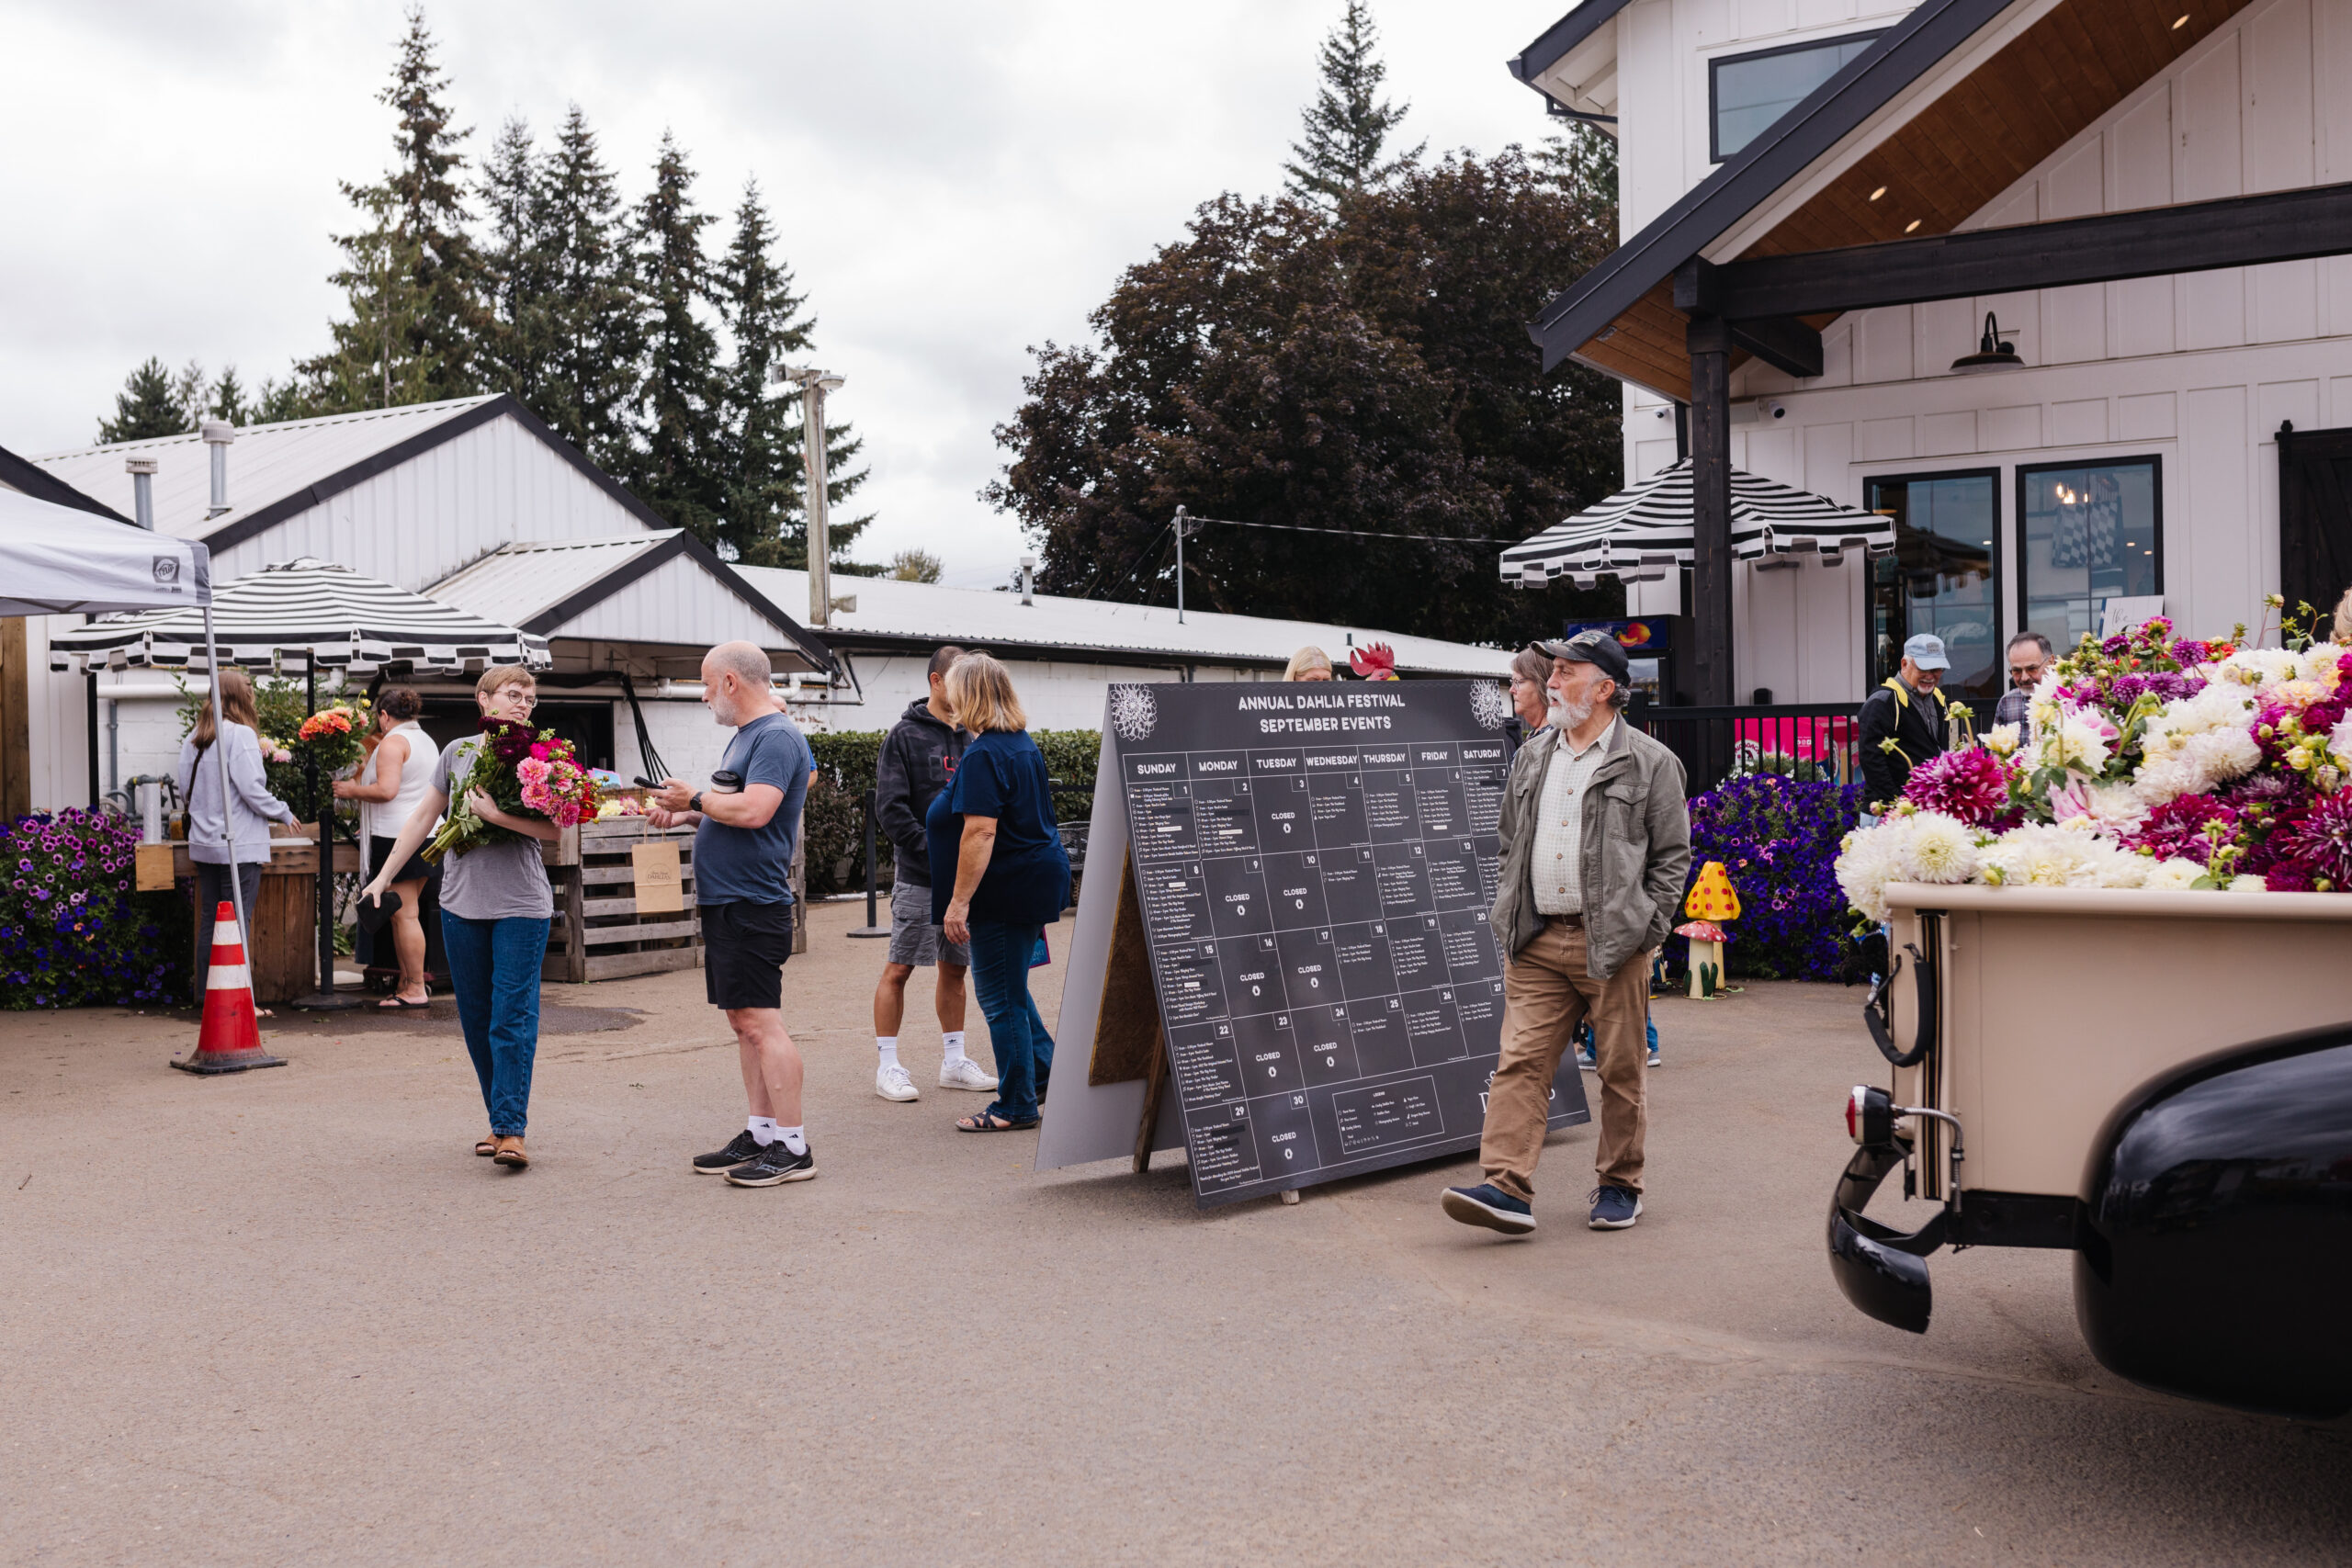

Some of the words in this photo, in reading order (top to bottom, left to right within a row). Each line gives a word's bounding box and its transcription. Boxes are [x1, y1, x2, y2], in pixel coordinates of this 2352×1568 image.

[1238, 695, 1294, 711] ANNUAL
[1296, 694, 1345, 709] DAHLIA
[1347, 694, 1406, 708] FESTIVAL
[1260, 716, 1339, 733] SEPTEMBER
[1340, 716, 1392, 730] EVENTS
[1137, 763, 1176, 774] SUNDAY
[1198, 761, 1238, 772] MONDAY
[1256, 758, 1296, 769] TUESDAY
[1306, 754, 1357, 767] WEDNESDAY
[1363, 752, 1406, 763] THURSDAY
[1421, 750, 1448, 761] FRIDAY
[1464, 749, 1500, 760] SATURDAY
[1405, 773, 1410, 782] 5
[1454, 772, 1460, 780] 6
[1501, 769, 1506, 777] 7
[1299, 780, 1305, 788] 3
[1353, 776, 1359, 784] 4
[1183, 785, 1188, 795] 1
[1242, 782, 1248, 791] 2
[1272, 812, 1295, 820] CLOSED
[1414, 846, 1421, 854] 12
[1464, 841, 1471, 850] 13
[1306, 855, 1315, 864] 10
[1363, 851, 1370, 859] 11
[1253, 860, 1259, 869] 9
[1193, 865, 1199, 874] 8
[1283, 887, 1307, 897] CLOSED
[1225, 893, 1250, 902] CLOSED
[1476, 912, 1486, 921] 20
[1427, 919, 1435, 927] 19
[1374, 925, 1383, 934] 18
[1321, 931, 1329, 940] 17
[1264, 938, 1272, 947] 16
[1204, 945, 1214, 954] 15
[1298, 964, 1322, 974] CLOSED
[1240, 972, 1264, 981] CLOSED
[1494, 983, 1502, 992] 27
[1442, 991, 1452, 1000] 26
[1389, 999, 1398, 1009] 25
[1335, 1008, 1344, 1017] 24
[1278, 1016, 1287, 1026] 23
[1218, 1025, 1228, 1035] 22
[1313, 1042, 1337, 1052] CLOSED
[1255, 1051, 1281, 1062] CLOSED
[1293, 1095, 1304, 1105] 30
[1235, 1106, 1245, 1116] 29
[1272, 1131, 1296, 1143] CLOSED
